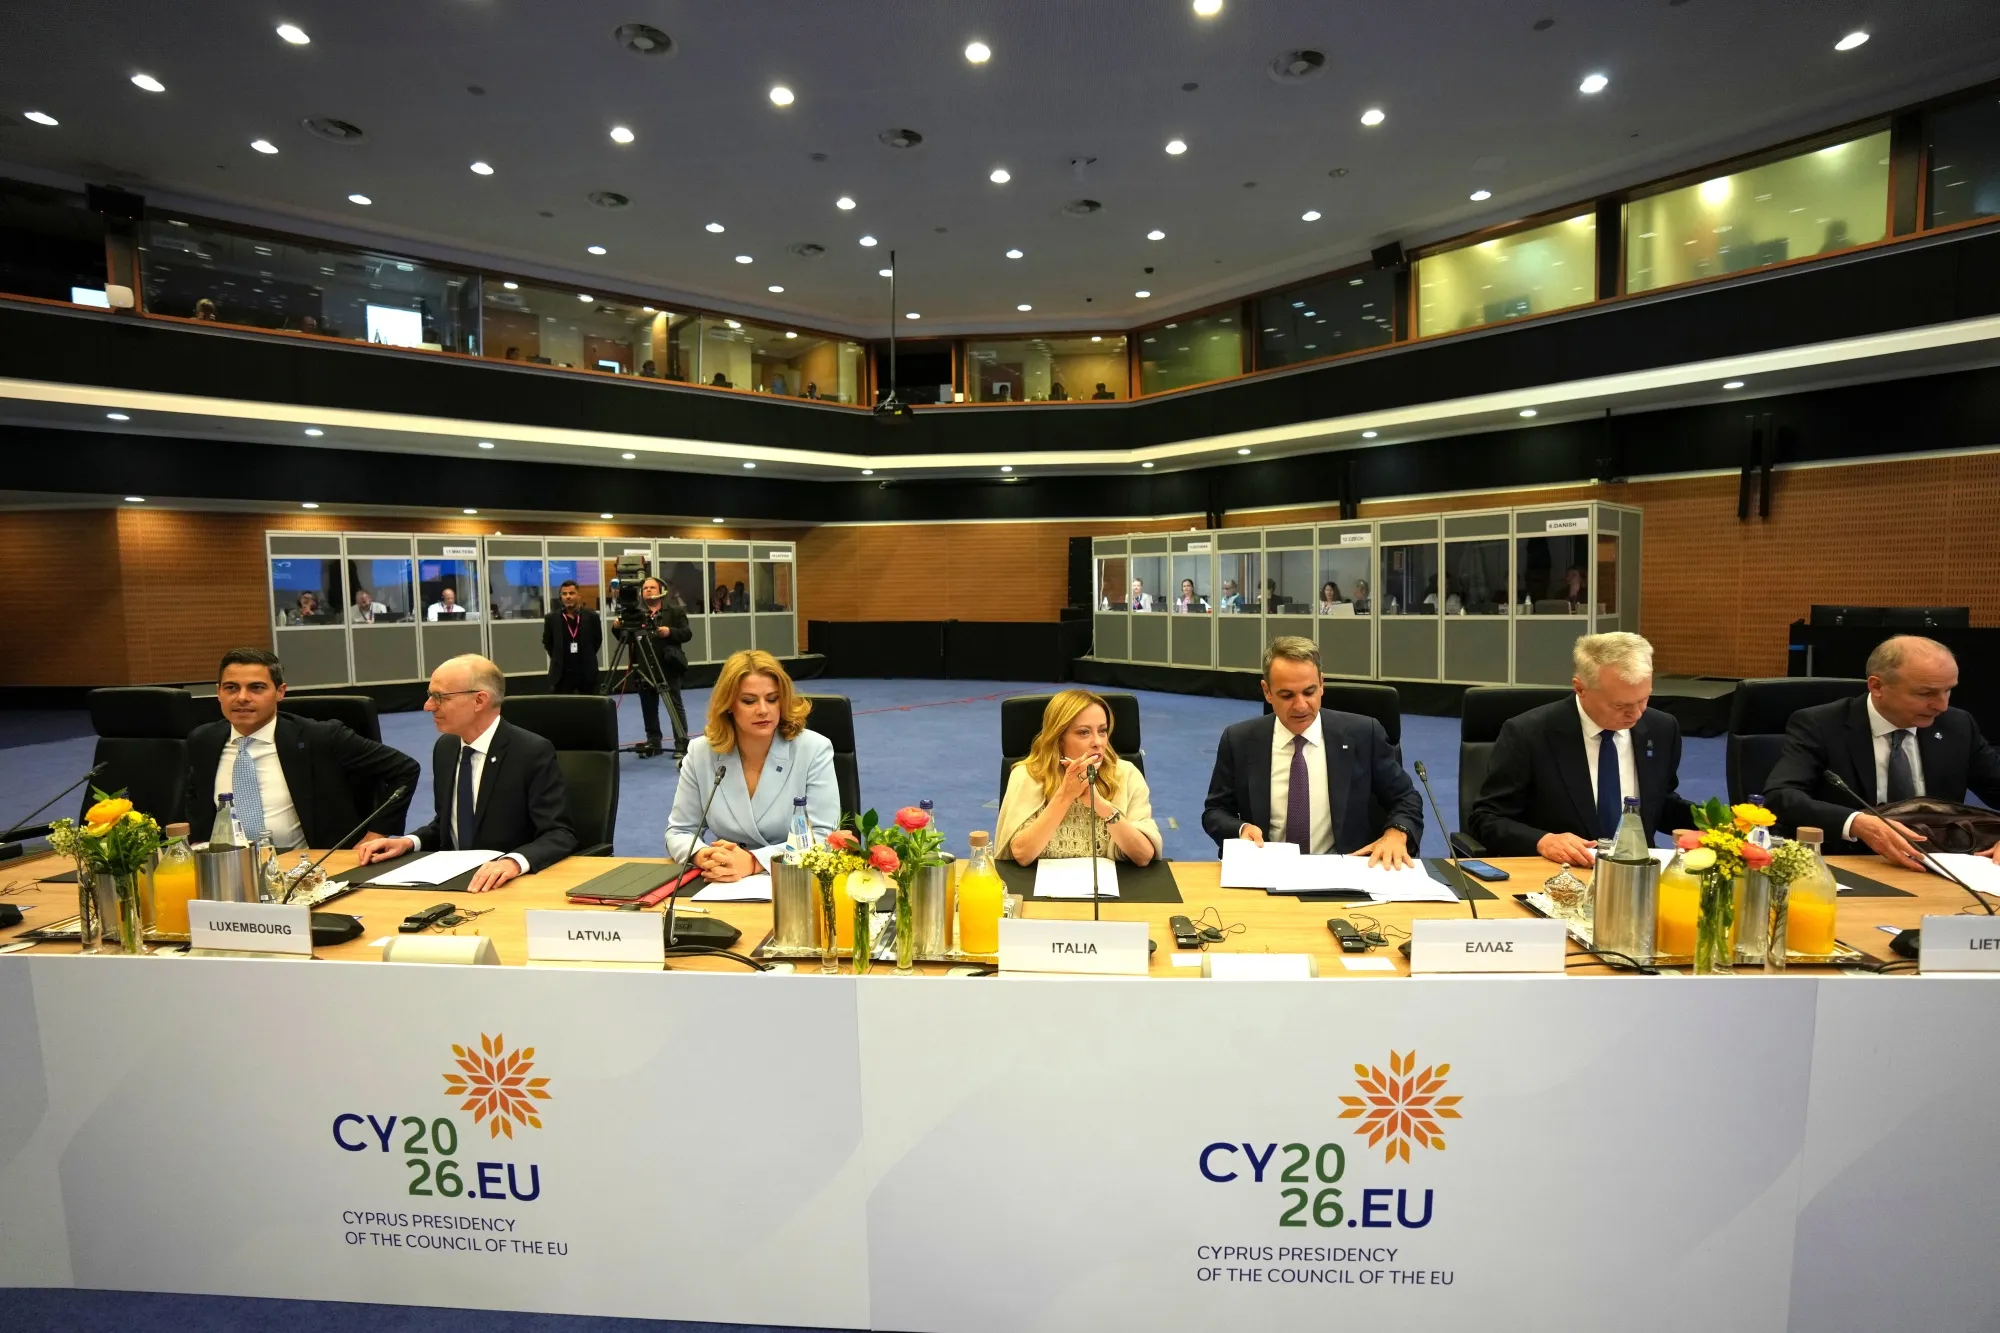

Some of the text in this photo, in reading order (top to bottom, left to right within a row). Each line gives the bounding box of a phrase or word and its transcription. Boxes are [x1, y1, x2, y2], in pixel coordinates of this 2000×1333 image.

[209, 921, 292, 935] LUXEMBOURG
[674, 923, 693, 931] OSCH
[567, 930, 621, 942] LATVIJA
[1052, 942, 1097, 954] ITALIA
[1465, 941, 1514, 953] ΕΛΛΑΣ
[342, 1210, 516, 1232] CYPRUS PRESIDENCY
[345, 1231, 568, 1256] OF THE COUNCIL OF THE EU
[1197, 1245, 1398, 1262] CYPRUS PRESIDENCY
[1197, 1267, 1454, 1285] OF THE COUNCIL OF THE EU
